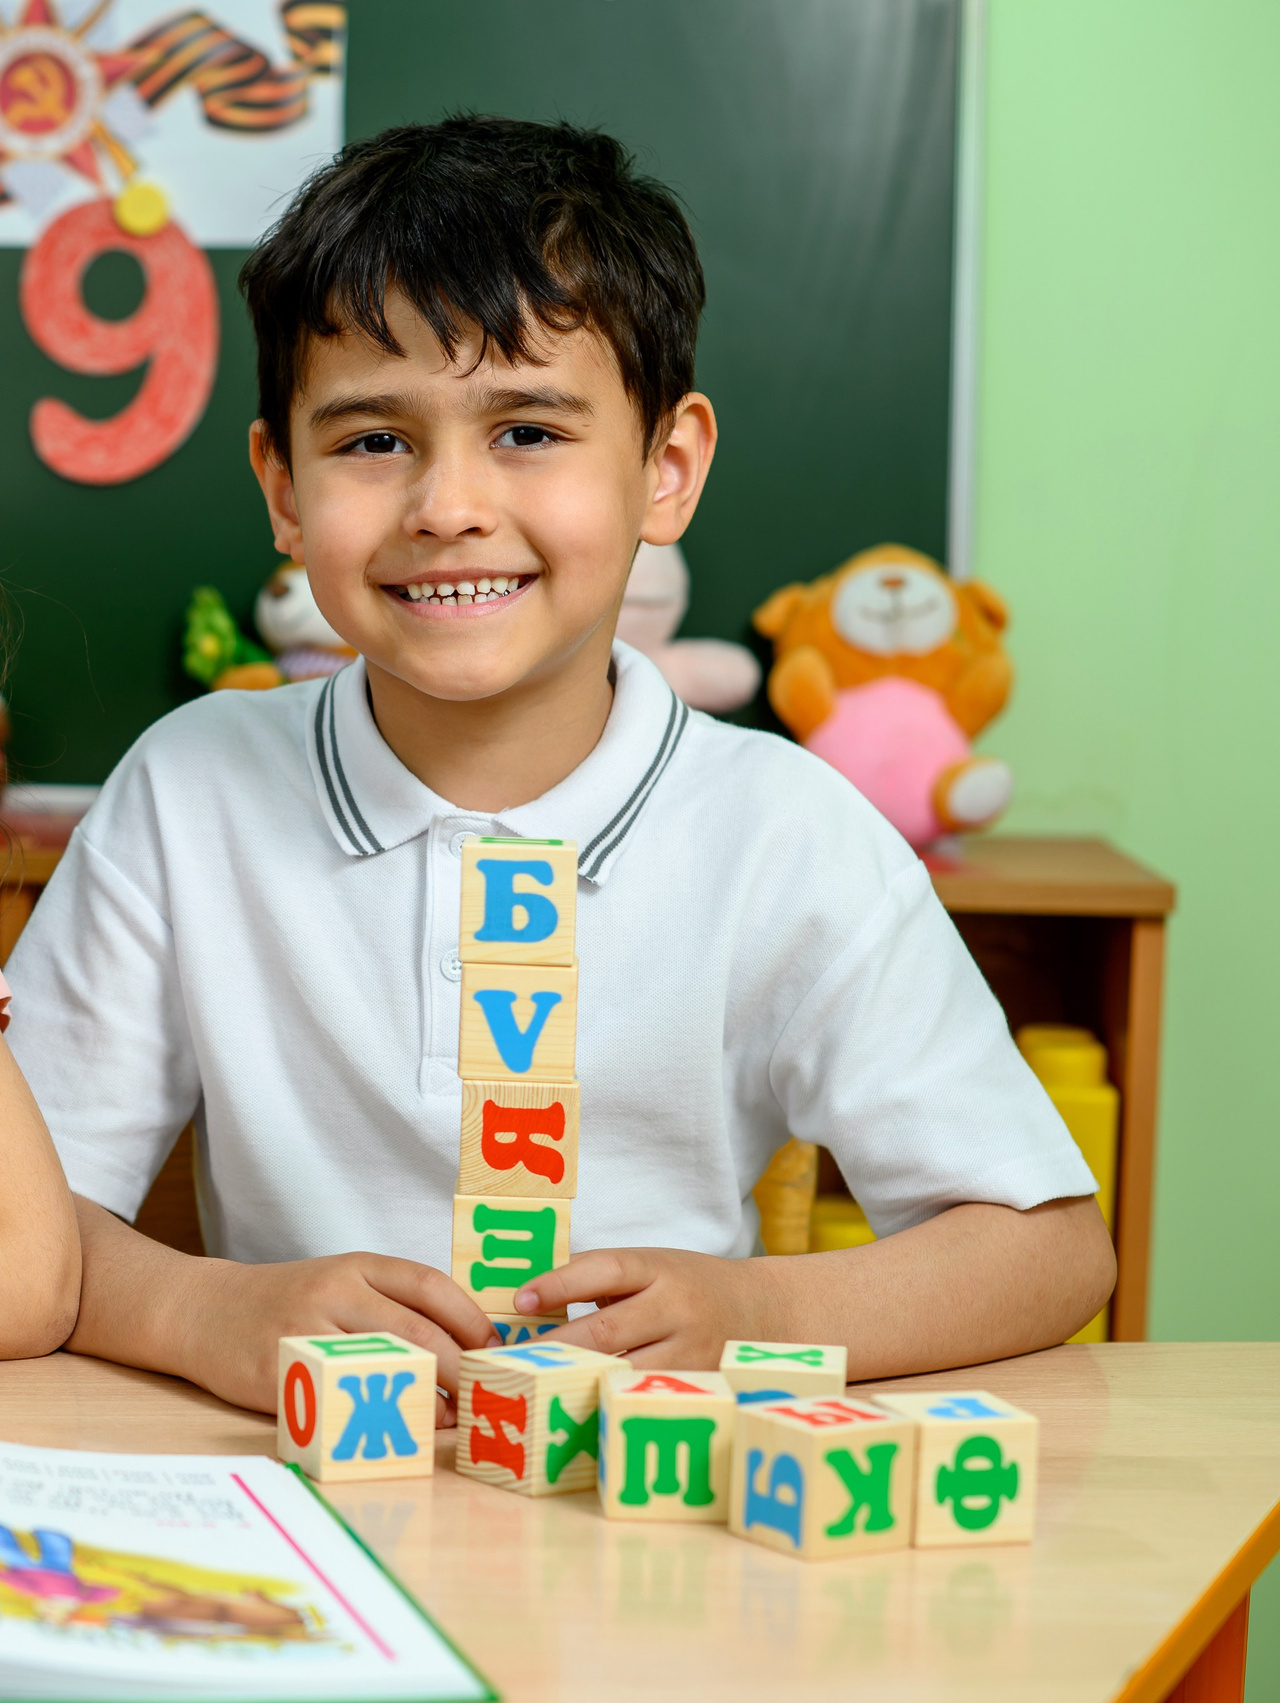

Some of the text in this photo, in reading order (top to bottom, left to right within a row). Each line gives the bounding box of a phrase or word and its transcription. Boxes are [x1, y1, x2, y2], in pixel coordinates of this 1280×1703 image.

[21, 197, 218, 485] 9
[473, 859, 558, 943] Б
[330, 1371, 419, 1461] Ж
[935, 1435, 1018, 1531] Ф
